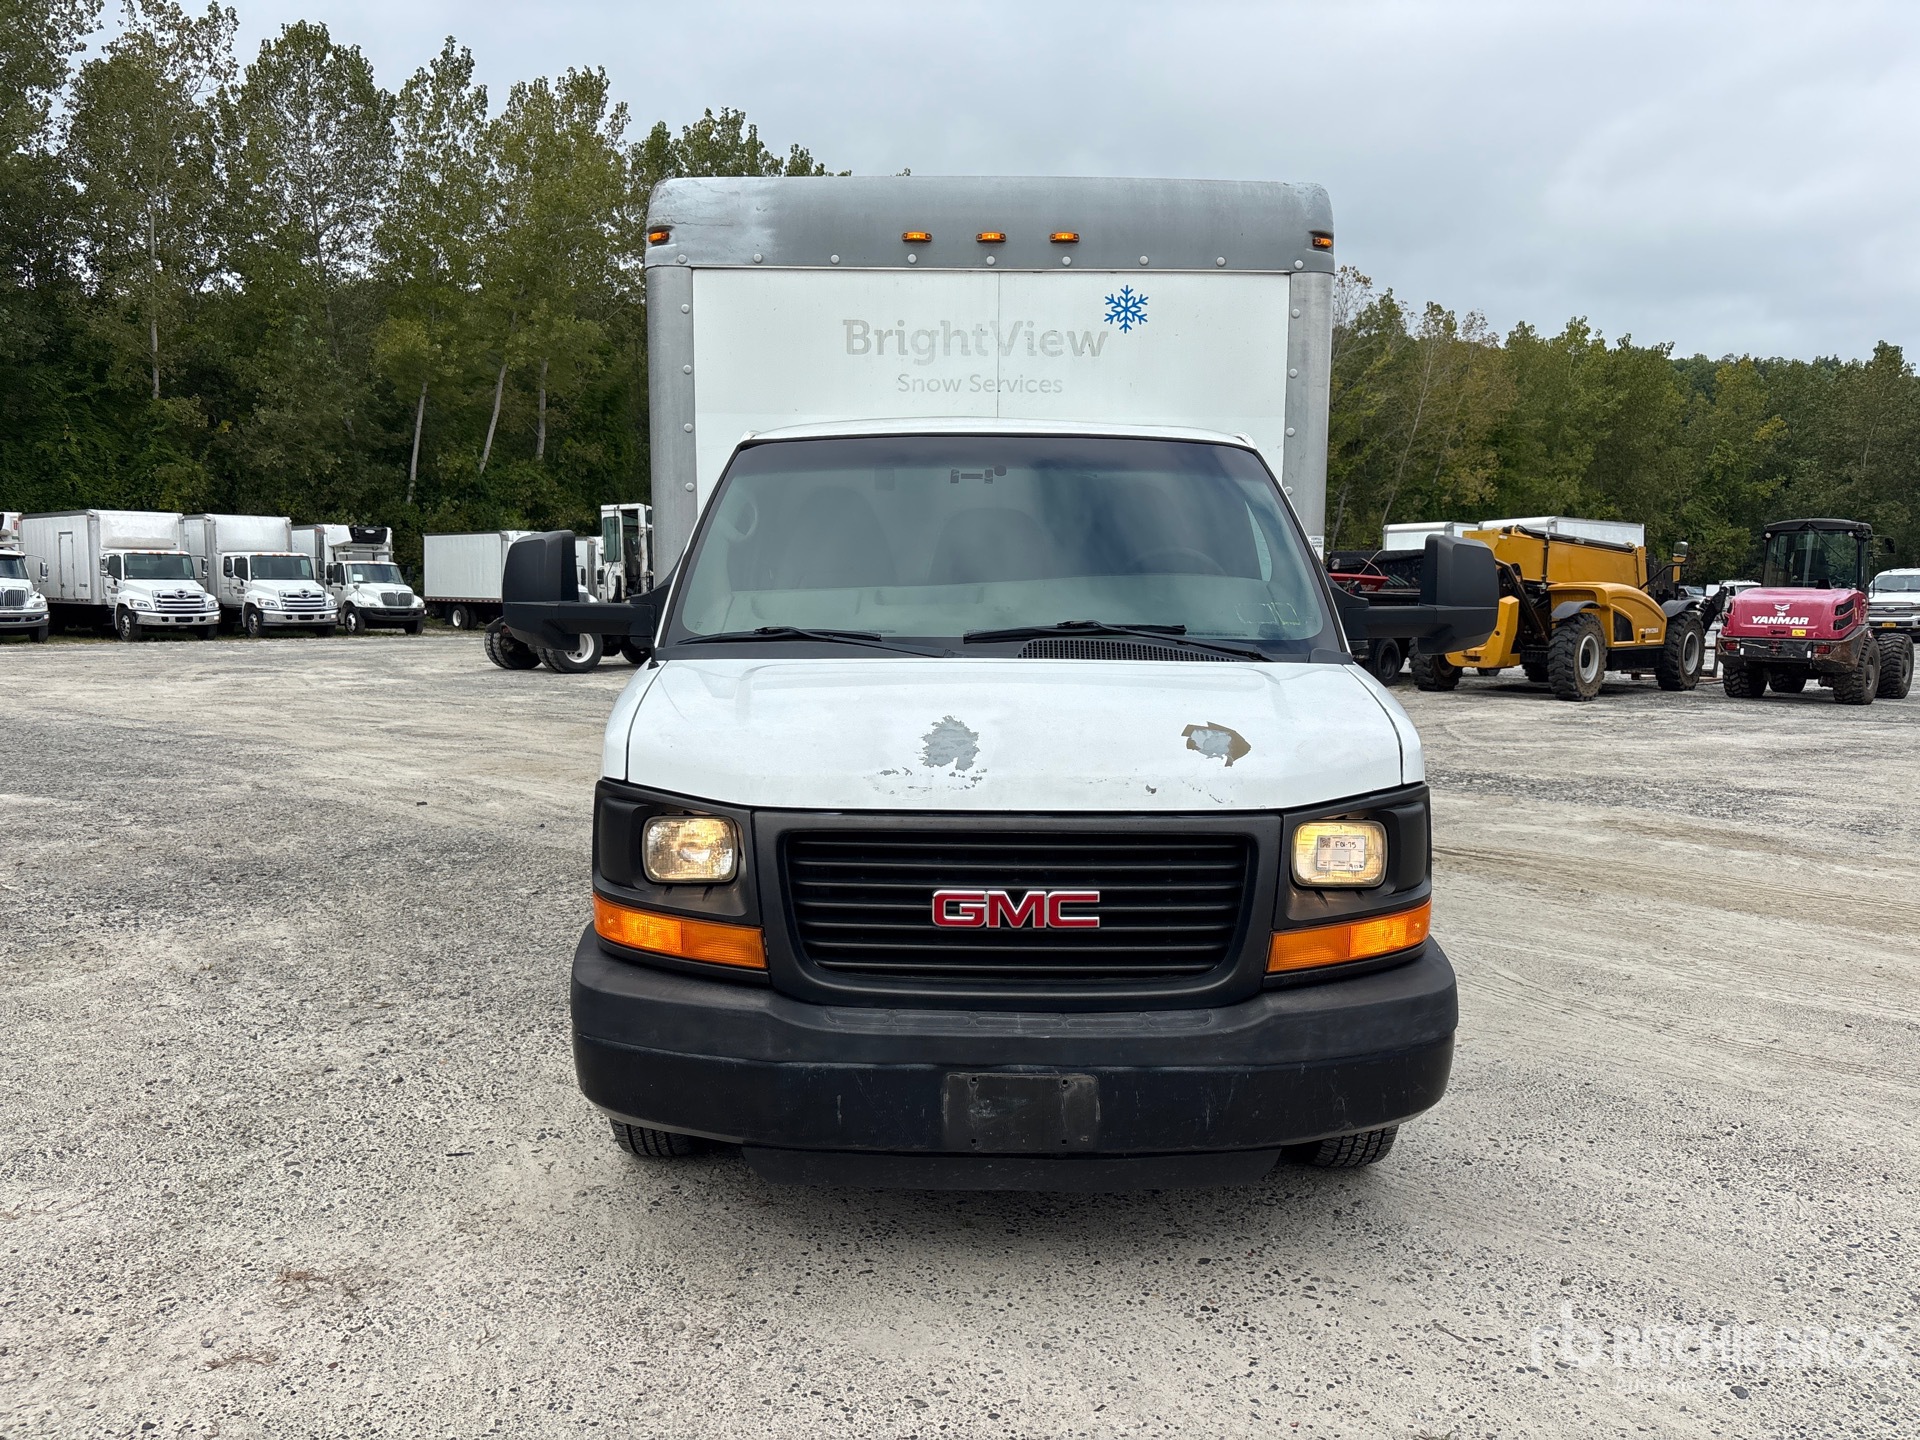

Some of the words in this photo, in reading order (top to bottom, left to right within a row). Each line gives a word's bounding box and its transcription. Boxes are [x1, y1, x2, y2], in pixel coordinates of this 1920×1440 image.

[843, 319, 1109, 365] BrightView
[898, 373, 962, 392] Snow
[969, 373, 1064, 393] Services
[1752, 615, 1809, 625] YANMAR
[932, 890, 1100, 928] GMC
